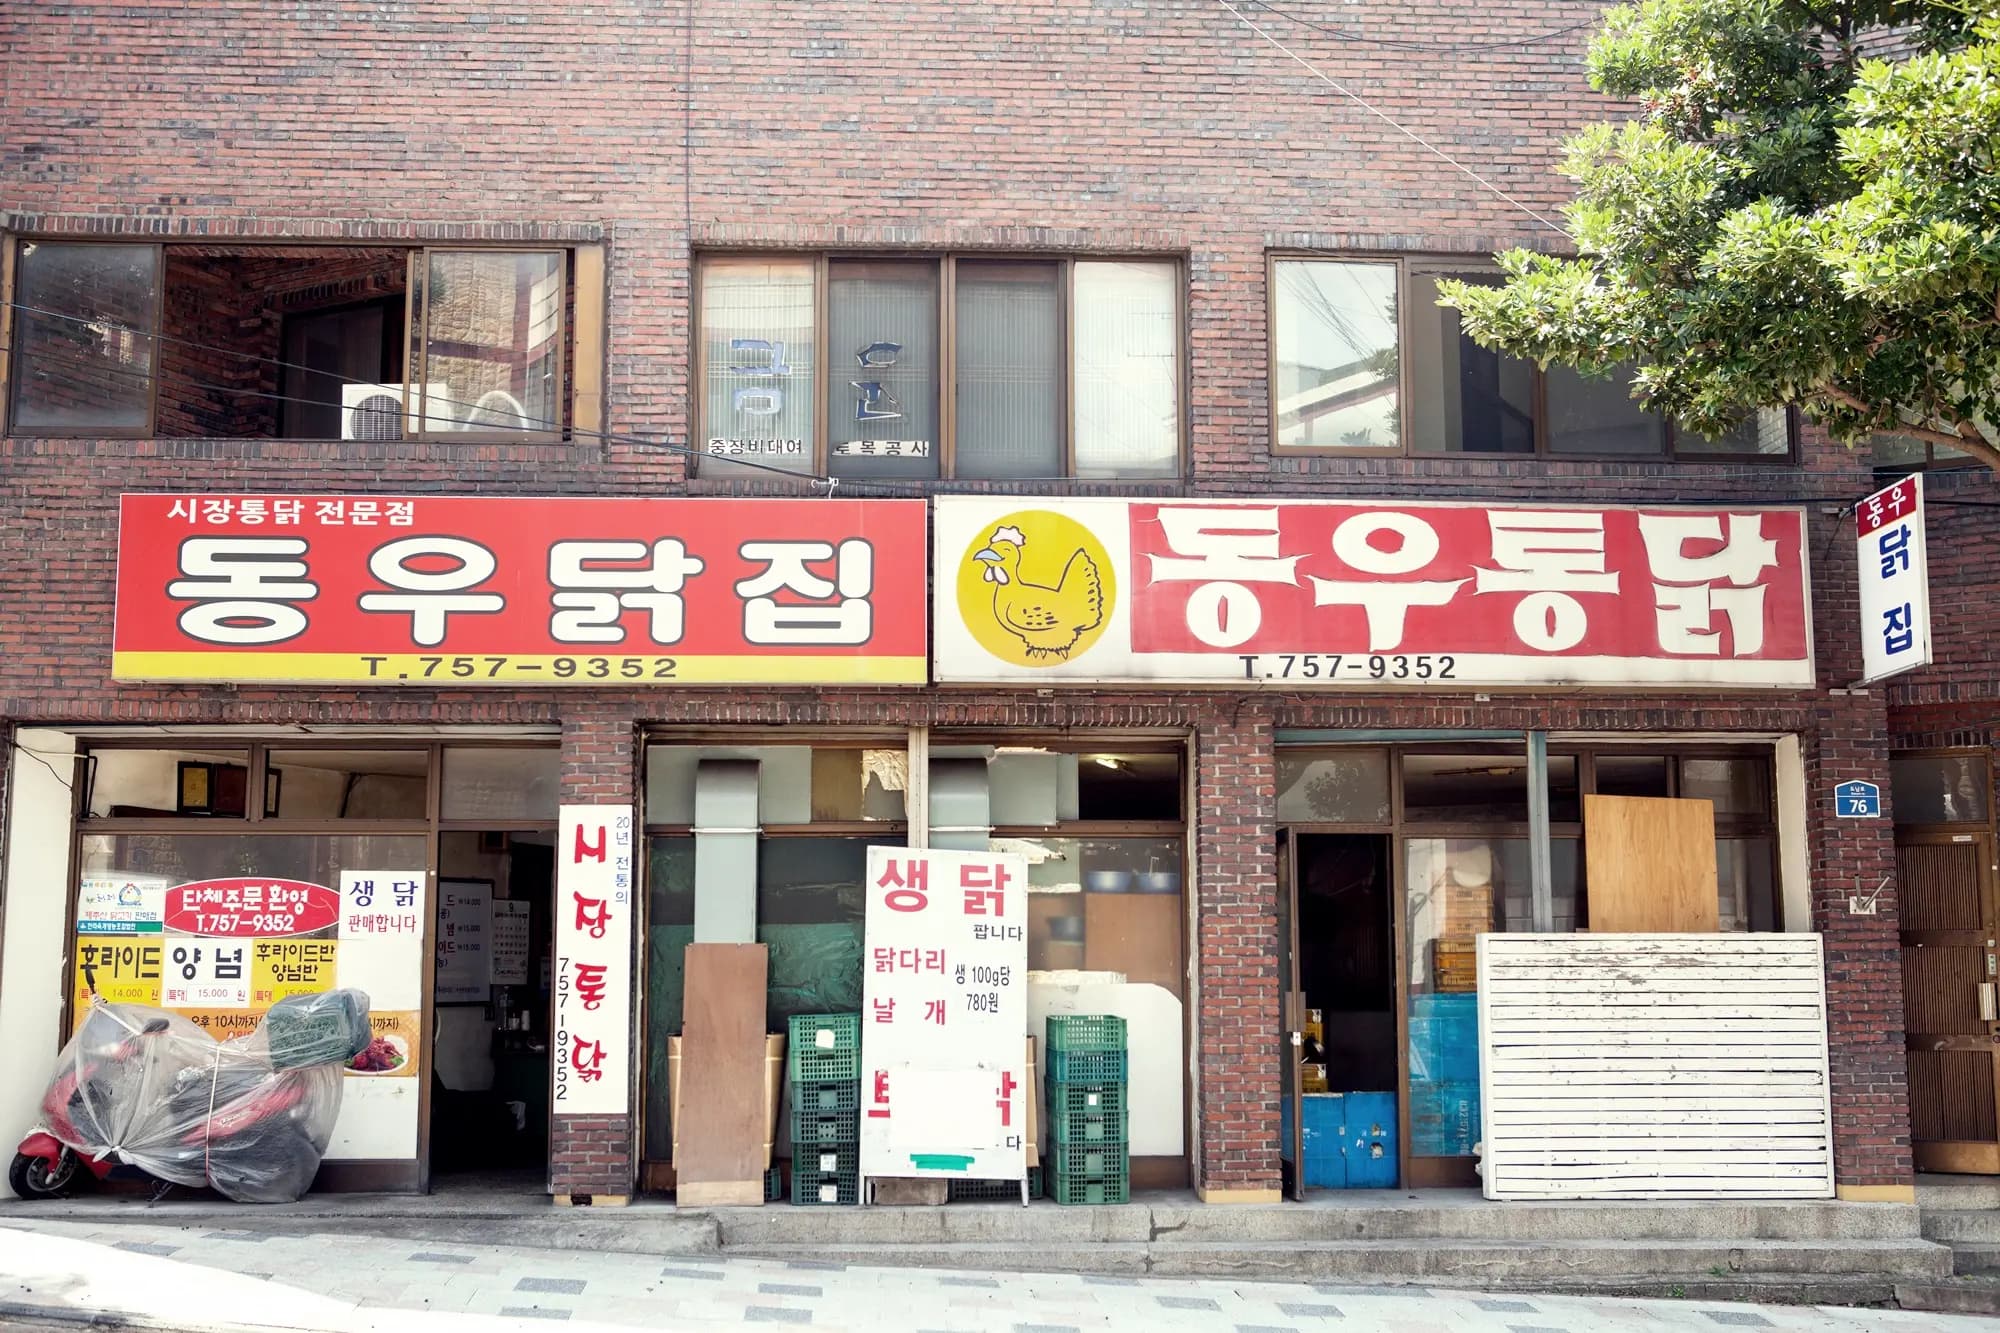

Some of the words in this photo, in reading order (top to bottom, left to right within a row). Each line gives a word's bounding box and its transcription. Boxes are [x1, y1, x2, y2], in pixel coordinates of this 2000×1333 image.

[711, 438, 802, 455] 중장비대여
[835, 440, 928, 456] 토목공사
[167, 499, 304, 525] 시장통닭
[315, 501, 415, 526] 전문점
[1867, 487, 1906, 528] 동우
[166, 533, 875, 647] 동우닭집
[1137, 506, 1779, 659] 동우통닭
[1879, 523, 1913, 656] 닭집
[360, 655, 678, 679] T.757-9352
[1240, 655, 1456, 680] T.757-9352
[1849, 799, 1868, 813] 76
[615, 816, 631, 846] 20년
[349, 880, 419, 907] 생닭
[614, 856, 629, 905] 전통의
[876, 859, 1012, 917] 생닭
[182, 886, 264, 911] 단체주문
[268, 884, 309, 915] 환영
[196, 914, 294, 933] T.757-9352
[347, 914, 417, 934] 판매합니다
[973, 924, 1023, 942] 팝니다
[79, 944, 161, 979] 후라이드
[173, 946, 243, 980] 양념
[256, 943, 335, 963] 후라이드반
[571, 823, 613, 1083] 시장통닭
[874, 947, 946, 975] 닭다리
[271, 964, 318, 983] 양념반
[955, 963, 966, 985] 생
[971, 965, 1011, 987] 100g당
[873, 997, 946, 1026] 날개
[966, 992, 999, 1014] 780원
[191, 1015, 211, 1028] 오후
[556, 957, 570, 1101] 757-9352
